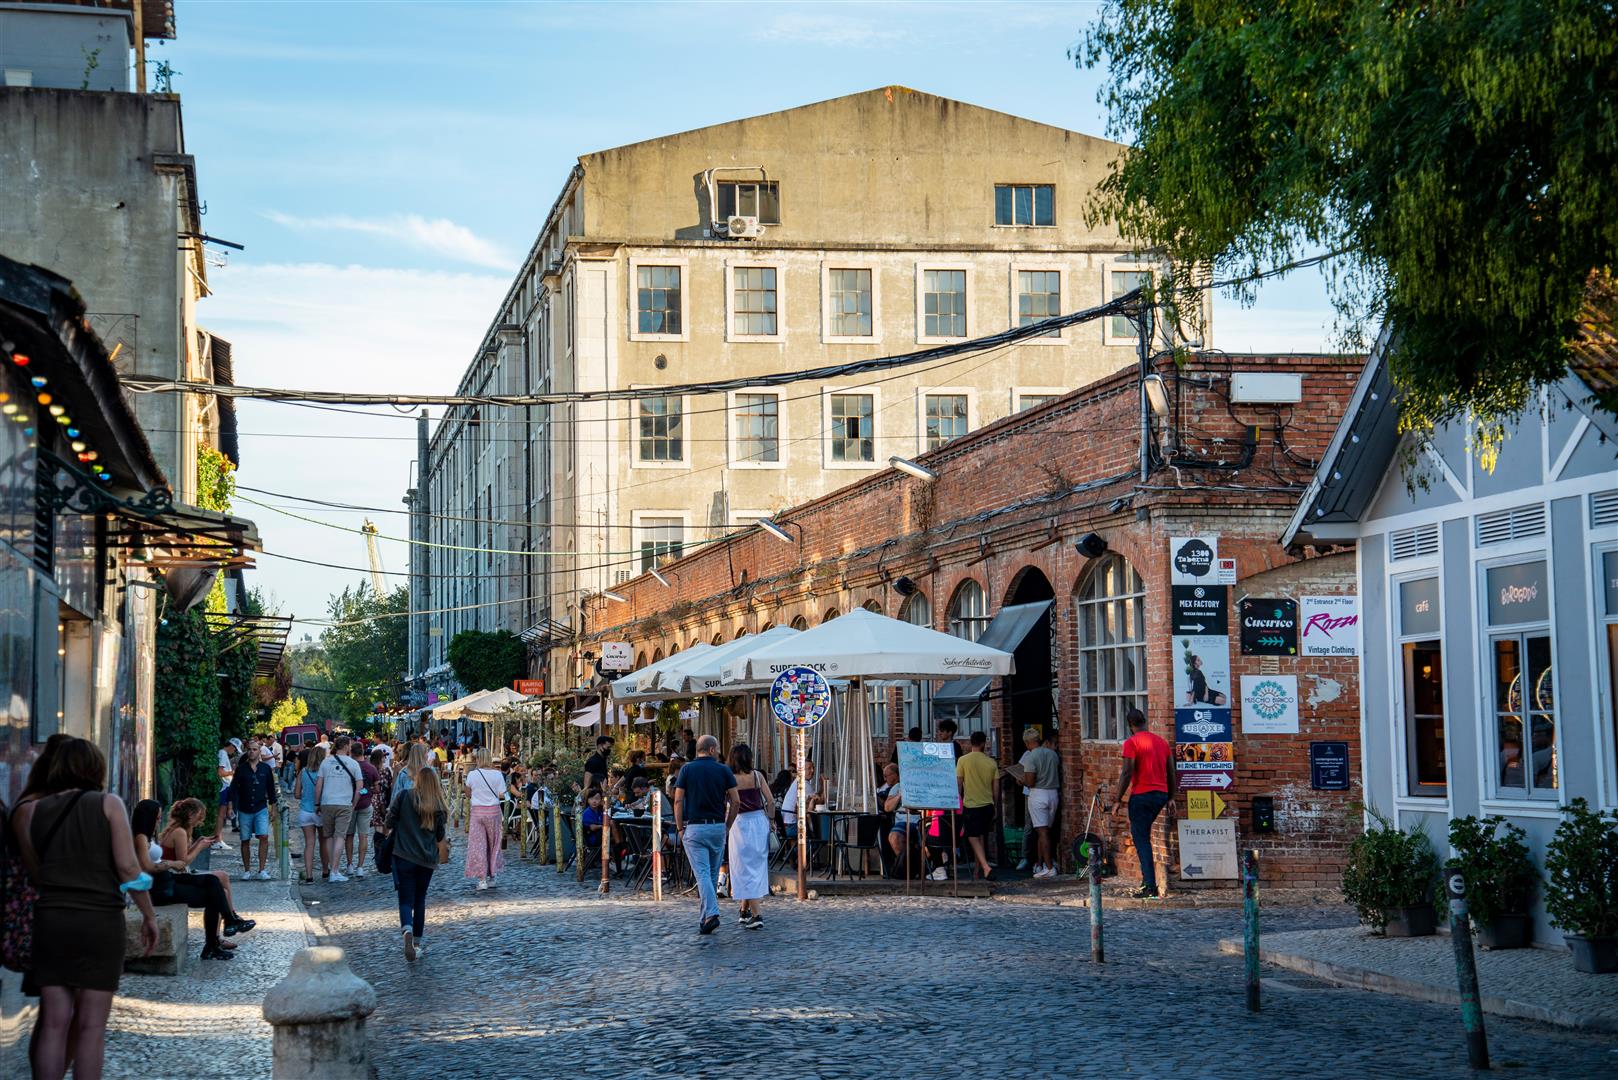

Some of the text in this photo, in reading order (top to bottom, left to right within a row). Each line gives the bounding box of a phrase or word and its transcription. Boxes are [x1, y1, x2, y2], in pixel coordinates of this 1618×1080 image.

[1179, 600, 1220, 608] MEX FACTORY
[1415, 599, 1429, 612] café
[1308, 646, 1355, 655] Vintage Clothing
